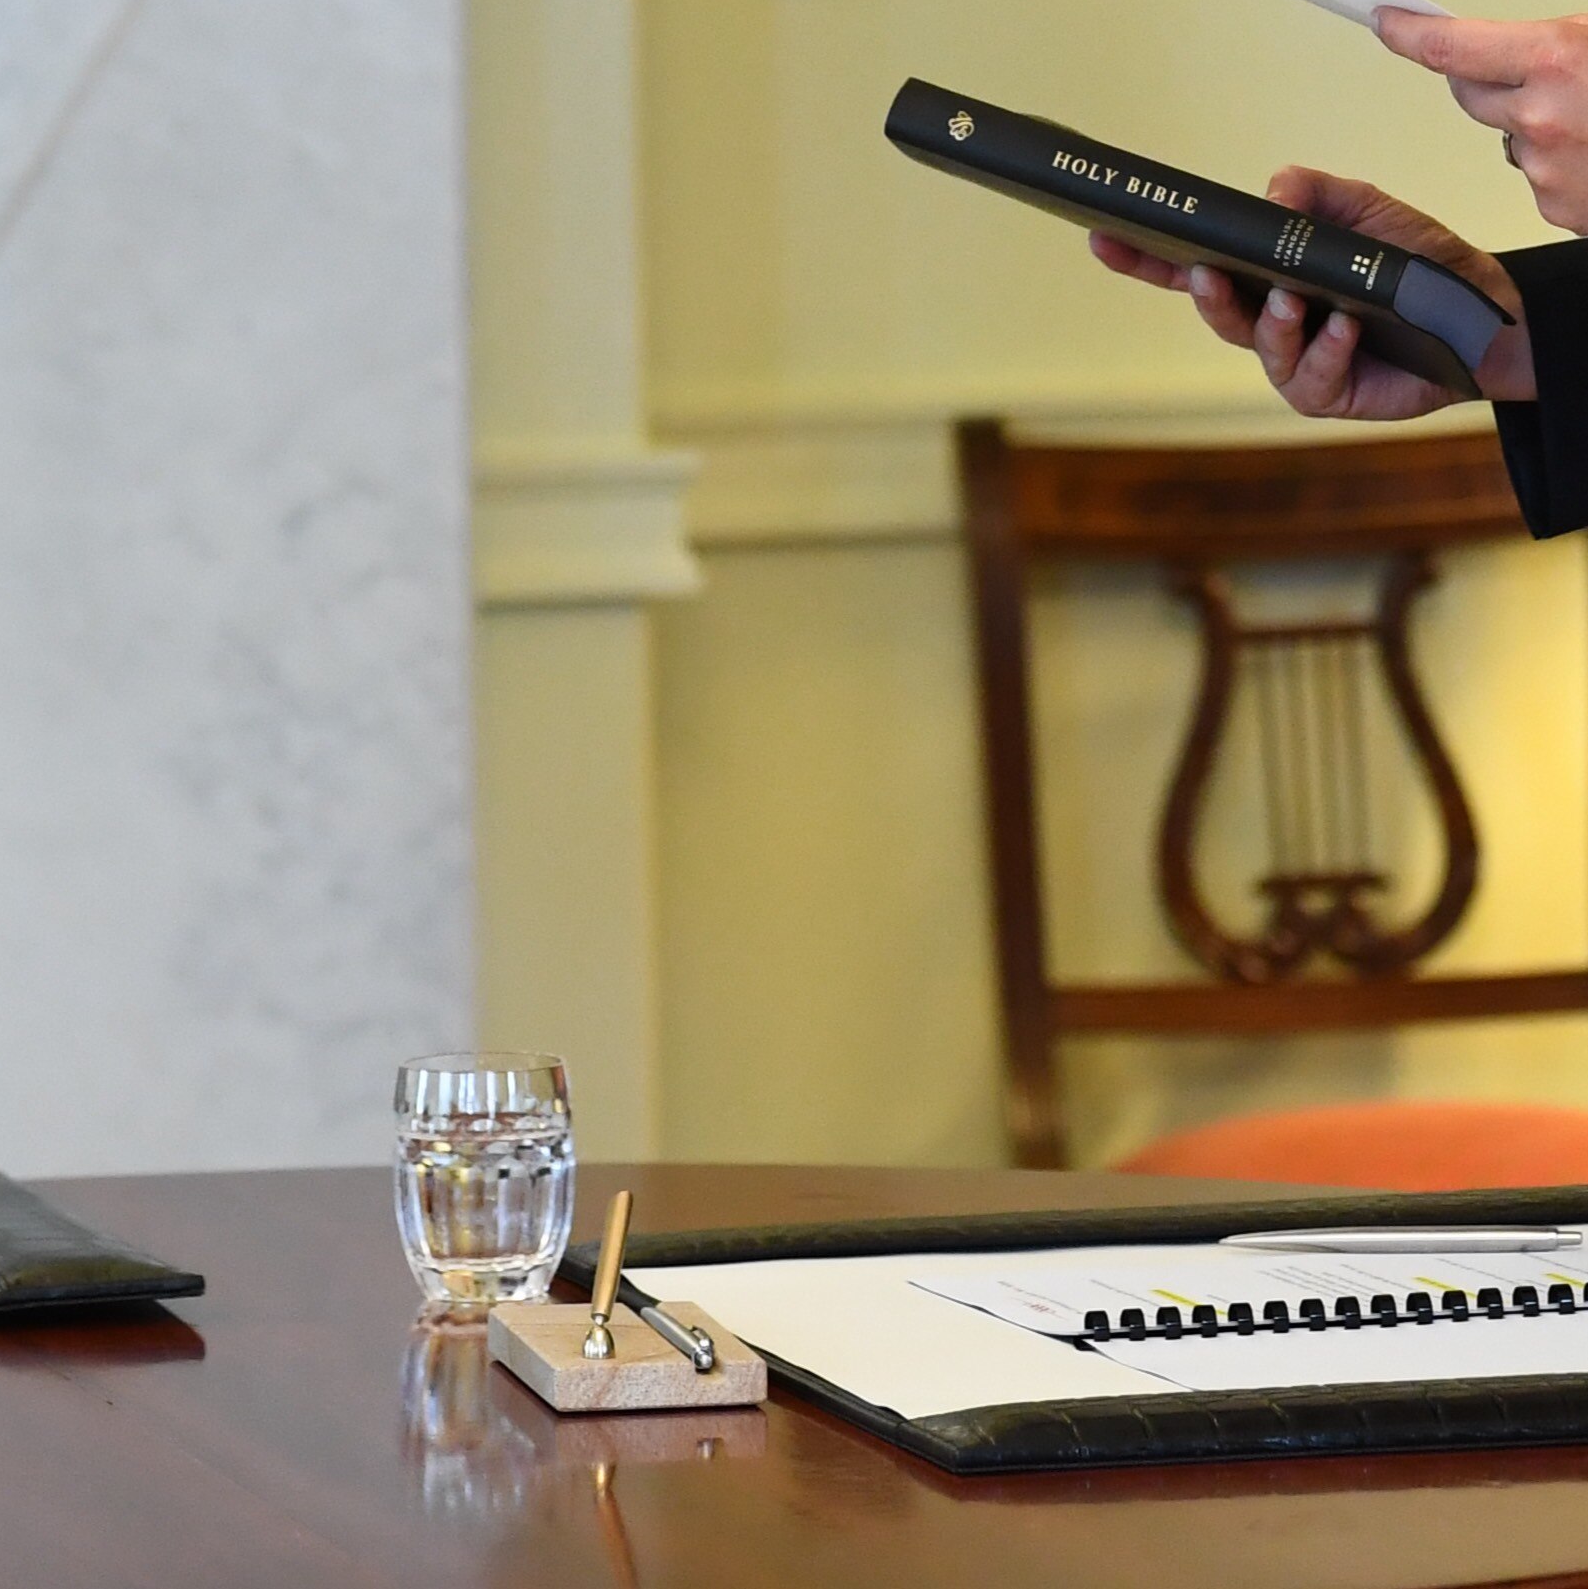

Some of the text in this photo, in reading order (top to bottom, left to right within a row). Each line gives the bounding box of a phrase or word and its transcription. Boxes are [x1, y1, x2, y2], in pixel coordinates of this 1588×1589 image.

[1051, 150, 1199, 214] HOLY BIBLE
[1273, 218, 1295, 259] ENGLISH
[1282, 218, 1307, 267] STANDARD
[1292, 225, 1315, 266] VERSION
